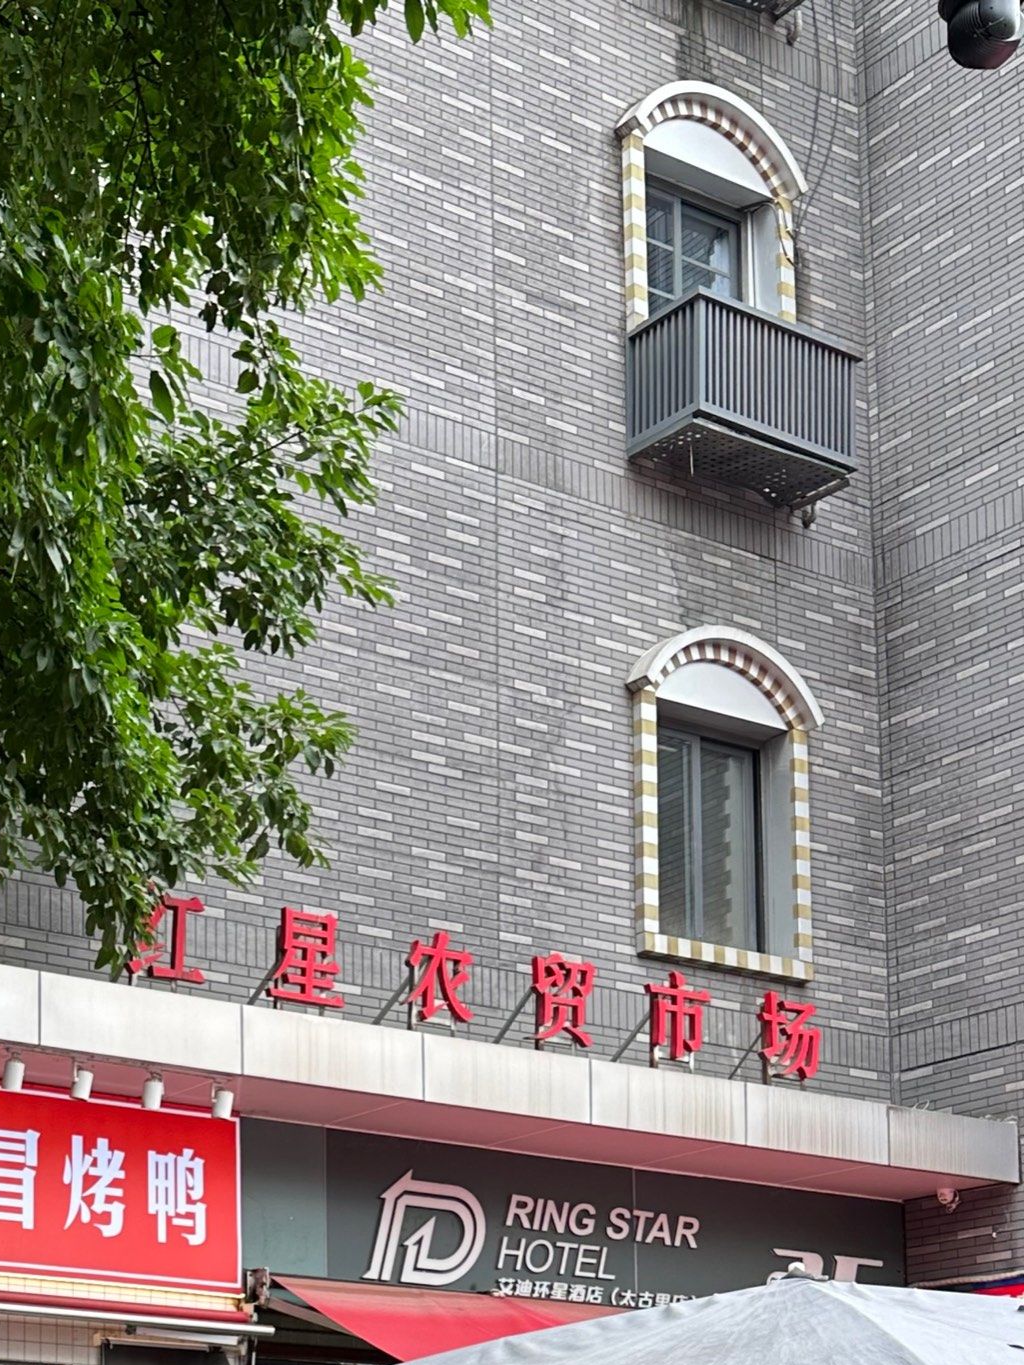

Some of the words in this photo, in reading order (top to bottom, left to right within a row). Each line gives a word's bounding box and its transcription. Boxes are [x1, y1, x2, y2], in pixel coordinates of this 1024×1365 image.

[126, 880, 822, 1080] 红星农贸市场
[506, 1193, 598, 1237] RING
[606, 1206, 700, 1249] STAR
[496, 1235, 616, 1281] HOTEL
